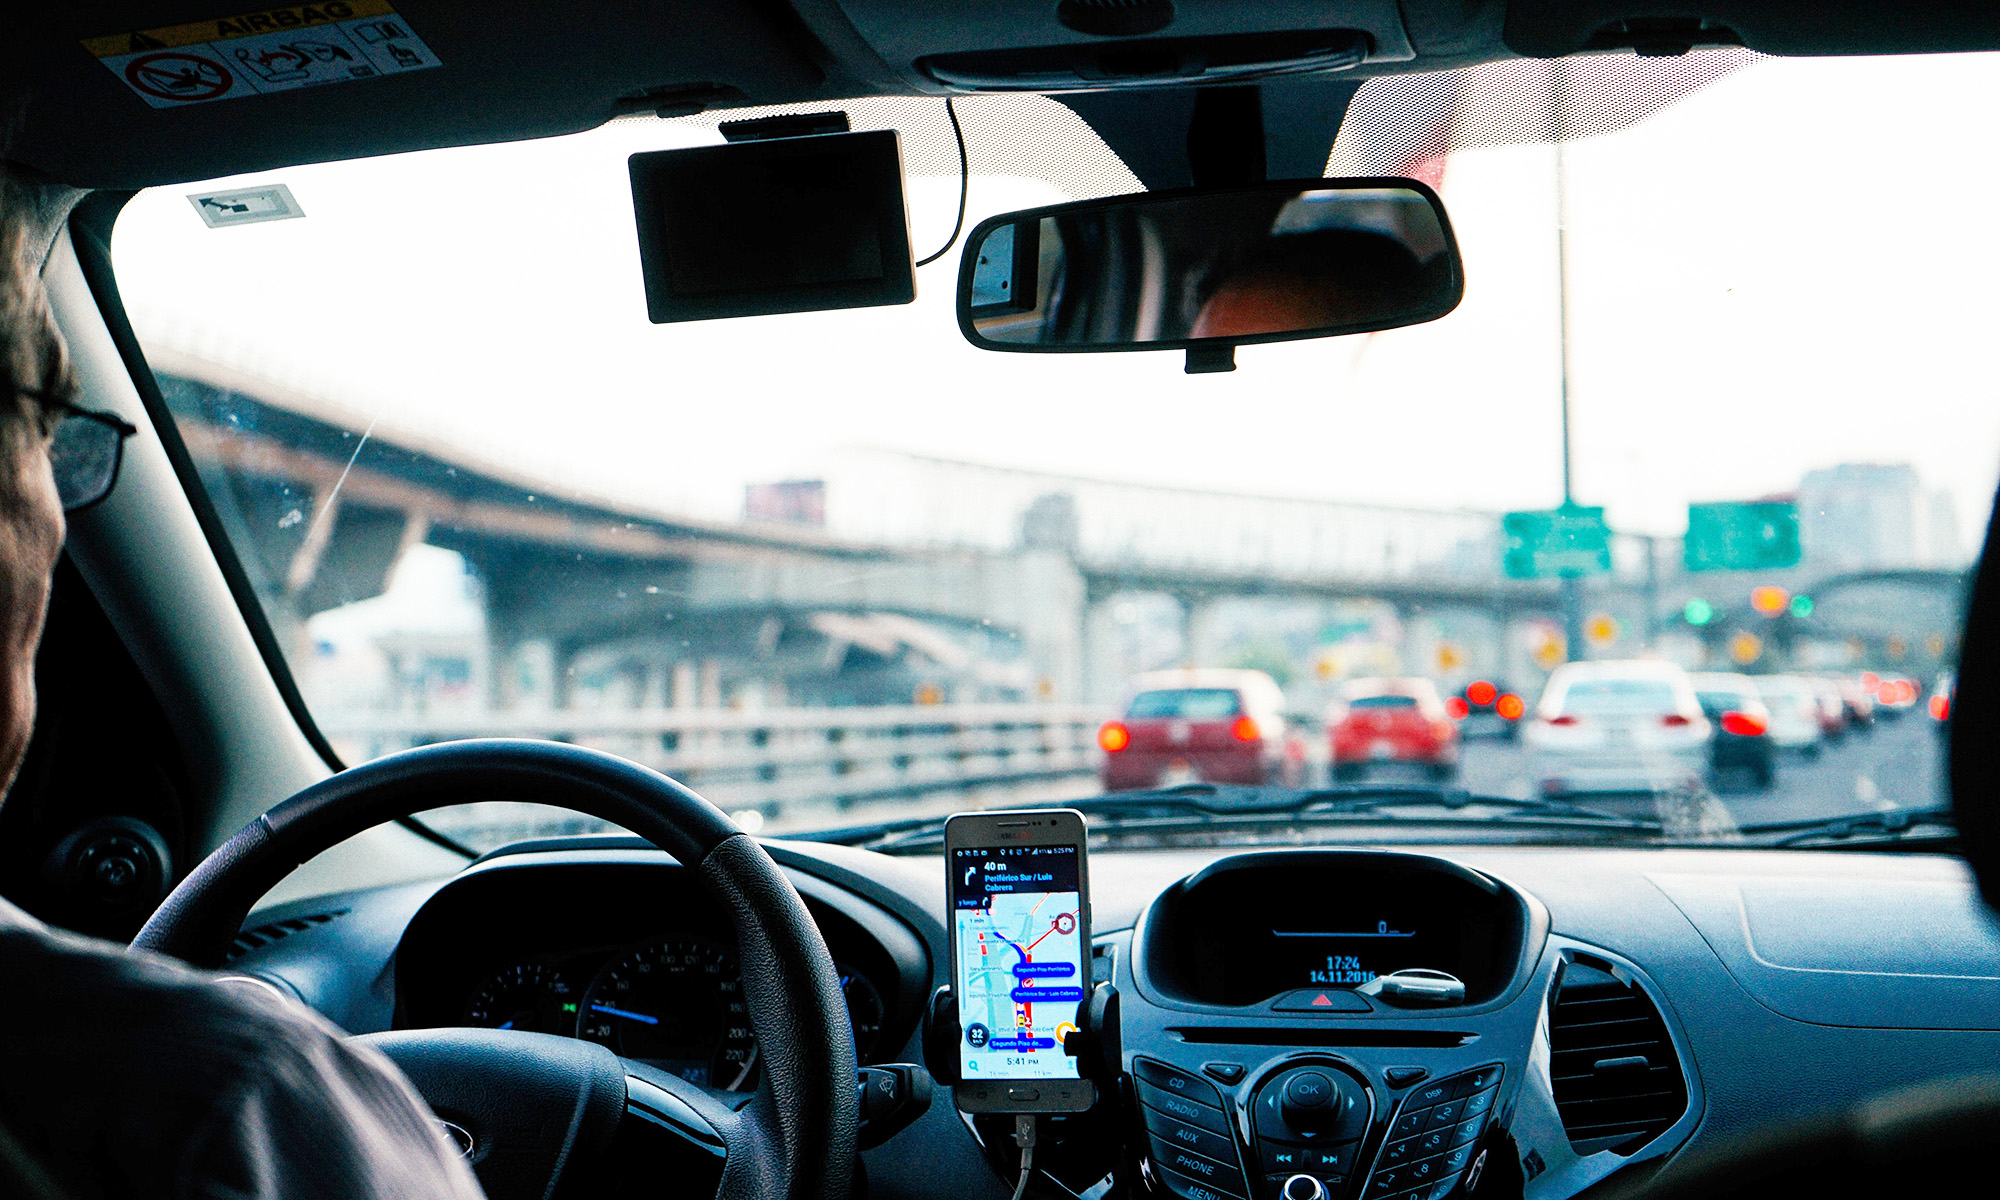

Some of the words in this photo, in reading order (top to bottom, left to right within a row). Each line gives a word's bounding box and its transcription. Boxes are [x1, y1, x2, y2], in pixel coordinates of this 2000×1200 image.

[216, 2, 353, 37] AIRBAG
[984, 862, 996, 871] 40
[1038, 873, 1053, 881] Luis
[1378, 920, 1387, 934] 0
[1327, 955, 1360, 970] 17:24
[1310, 970, 1376, 983] 14.11.2016
[598, 1025, 610, 1037] 20
[728, 1028, 747, 1038] 200
[972, 1029, 983, 1038] 32
[726, 1049, 745, 1060] 220
[1169, 1078, 1185, 1089] CD
[1299, 1084, 1319, 1094] OK
[1425, 1088, 1443, 1099] DSP
[1476, 1096, 1485, 1105] 3
[1165, 1100, 1199, 1118] RADIO
[1443, 1107, 1452, 1116] 2
[1412, 1116, 1418, 1125] 1
[1466, 1123, 1474, 1132] 6
[1176, 1129, 1200, 1143] AUX
[1431, 1134, 1440, 1144] 5
[1398, 1144, 1405, 1152] 4
[1454, 1152, 1463, 1161] 9
[1176, 1155, 1215, 1176] PHONE
[1420, 1163, 1429, 1173] 8
[1387, 1173, 1396, 1183] 7
